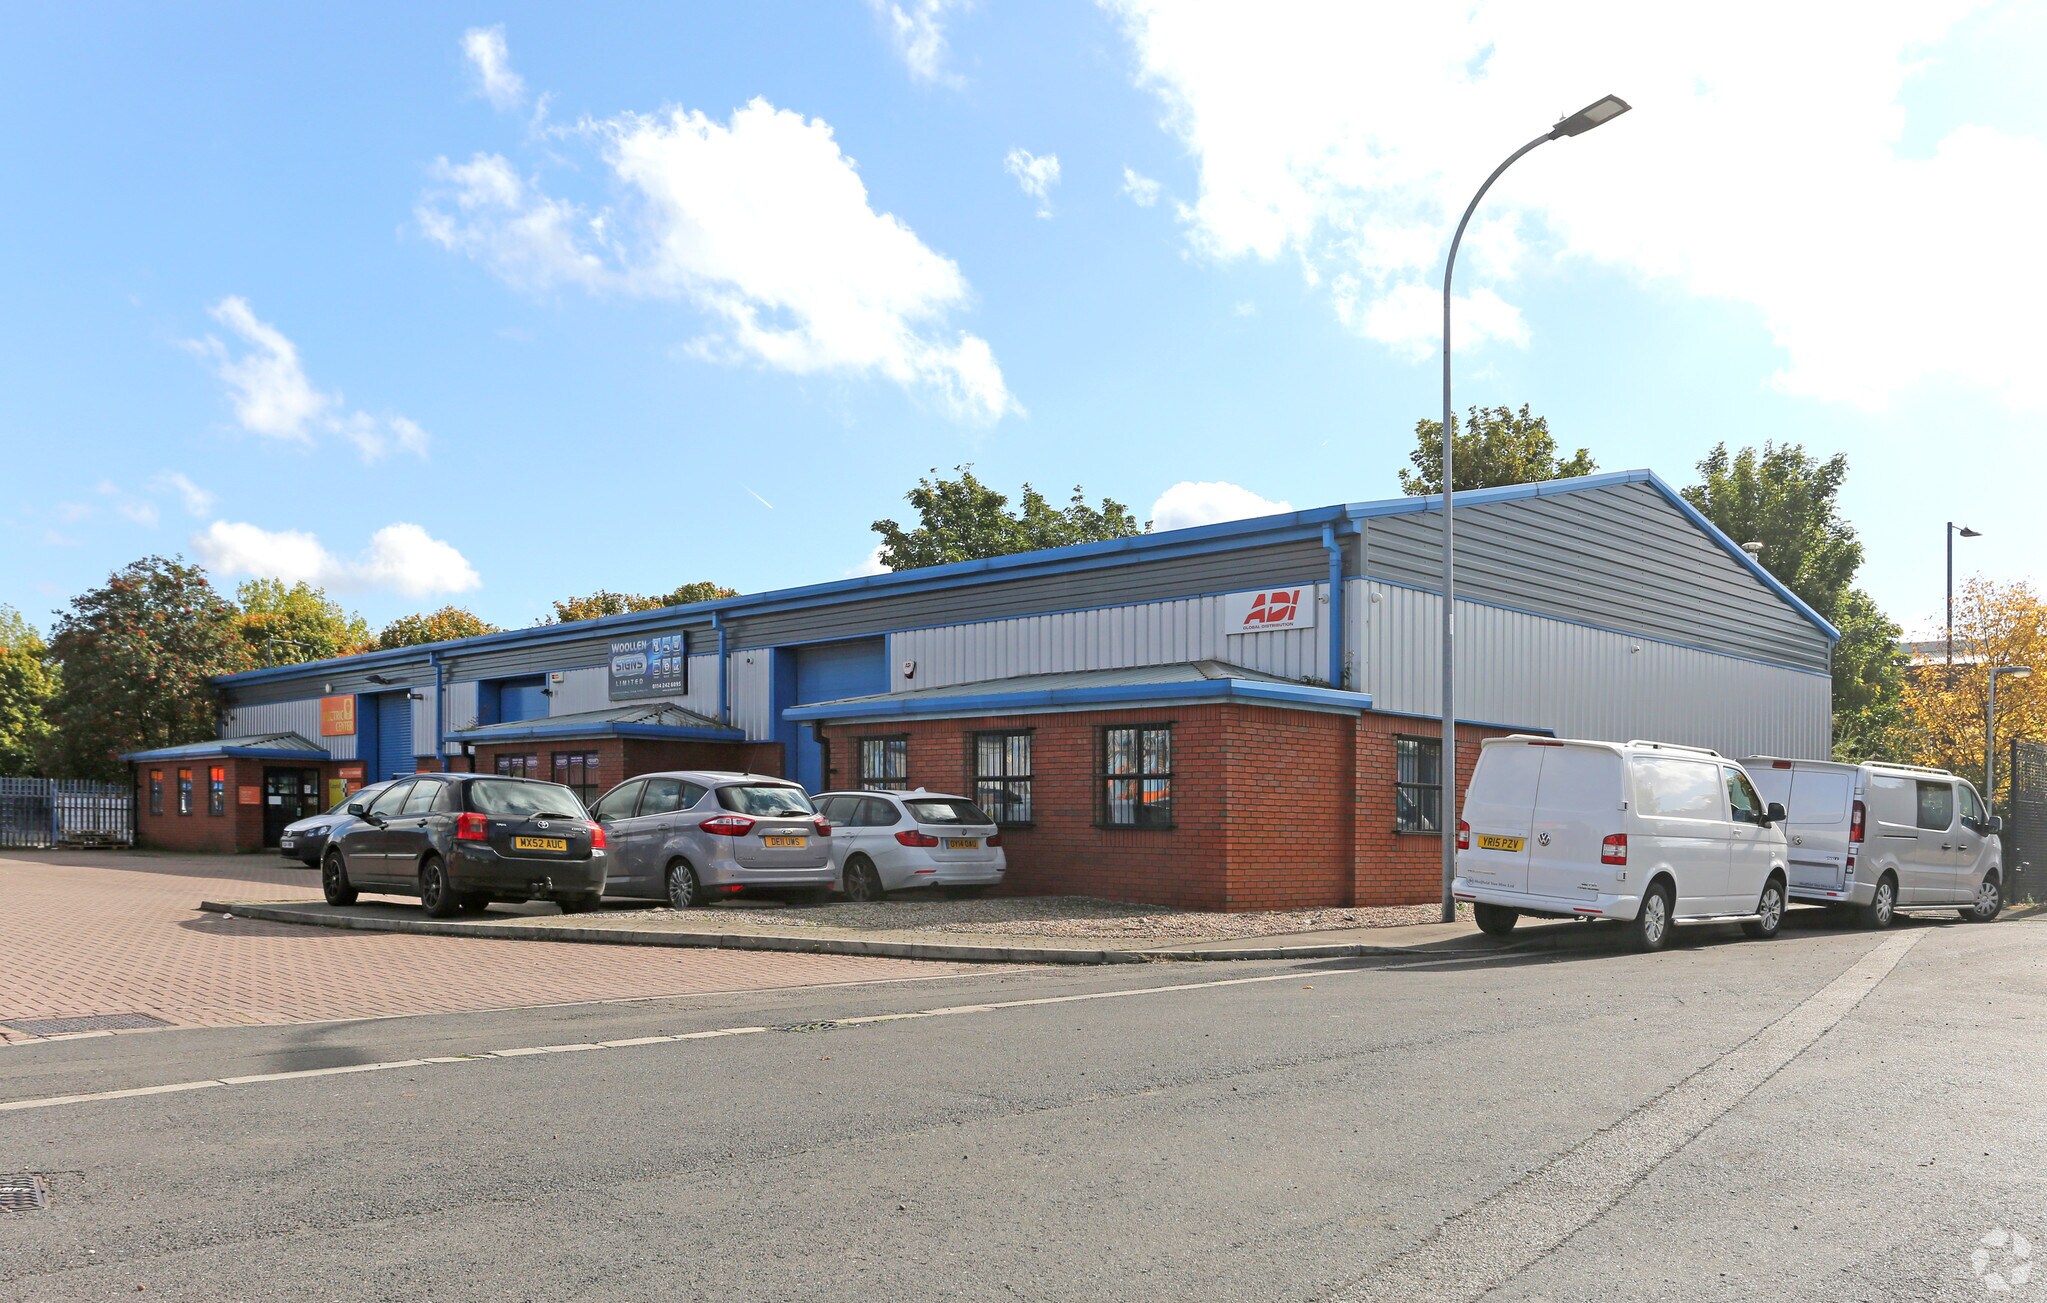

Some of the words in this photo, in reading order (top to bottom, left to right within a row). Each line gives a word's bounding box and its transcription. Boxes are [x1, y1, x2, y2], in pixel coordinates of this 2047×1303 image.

[1243, 590, 1300, 624] ADI
[611, 640, 647, 654] WOOLLEN
[616, 658, 643, 672] SIGNS
[616, 678, 644, 687] LIMITED
[520, 838, 544, 848] MX52
[546, 840, 563, 849] AUC
[1482, 837, 1500, 847] YR15
[1501, 838, 1519, 849] PZV
